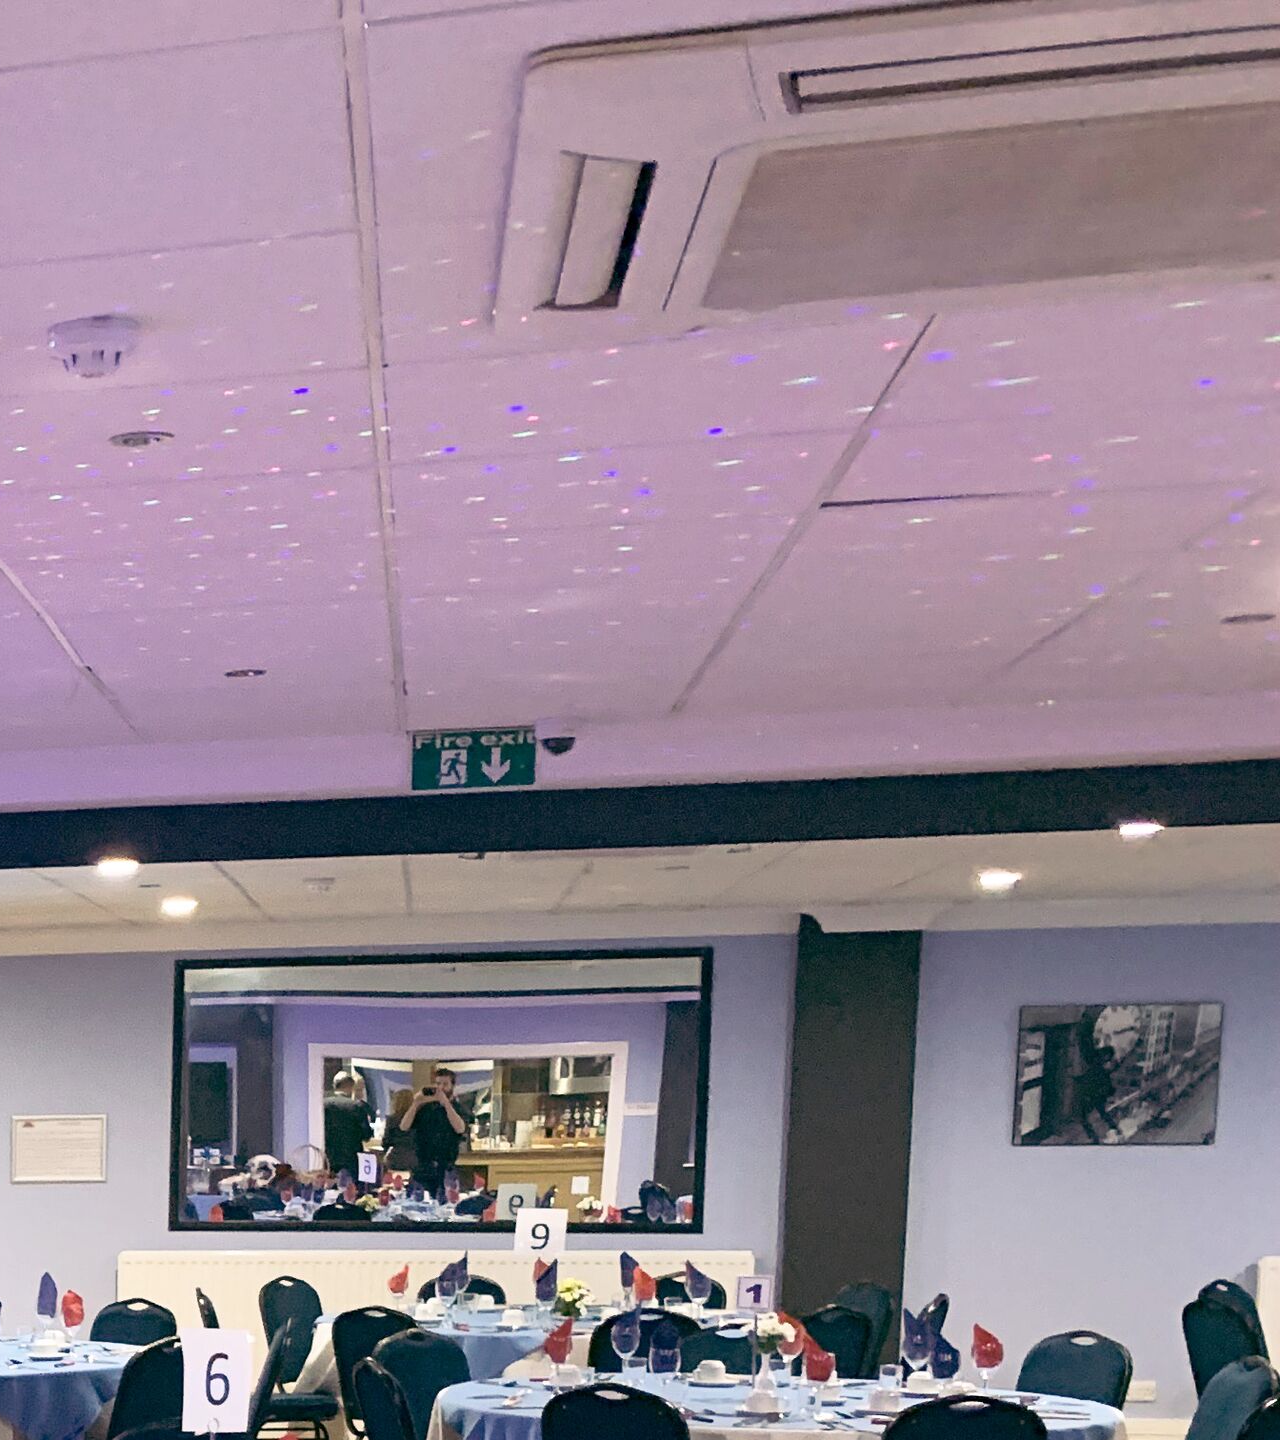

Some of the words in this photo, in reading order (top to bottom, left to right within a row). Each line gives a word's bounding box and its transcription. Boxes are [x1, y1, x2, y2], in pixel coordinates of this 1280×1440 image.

[415, 732, 473, 750] Fire
[480, 730, 536, 747] exit
[531, 1223, 550, 1250] 9
[745, 1284, 762, 1304] 1
[206, 1352, 230, 1406] 6
